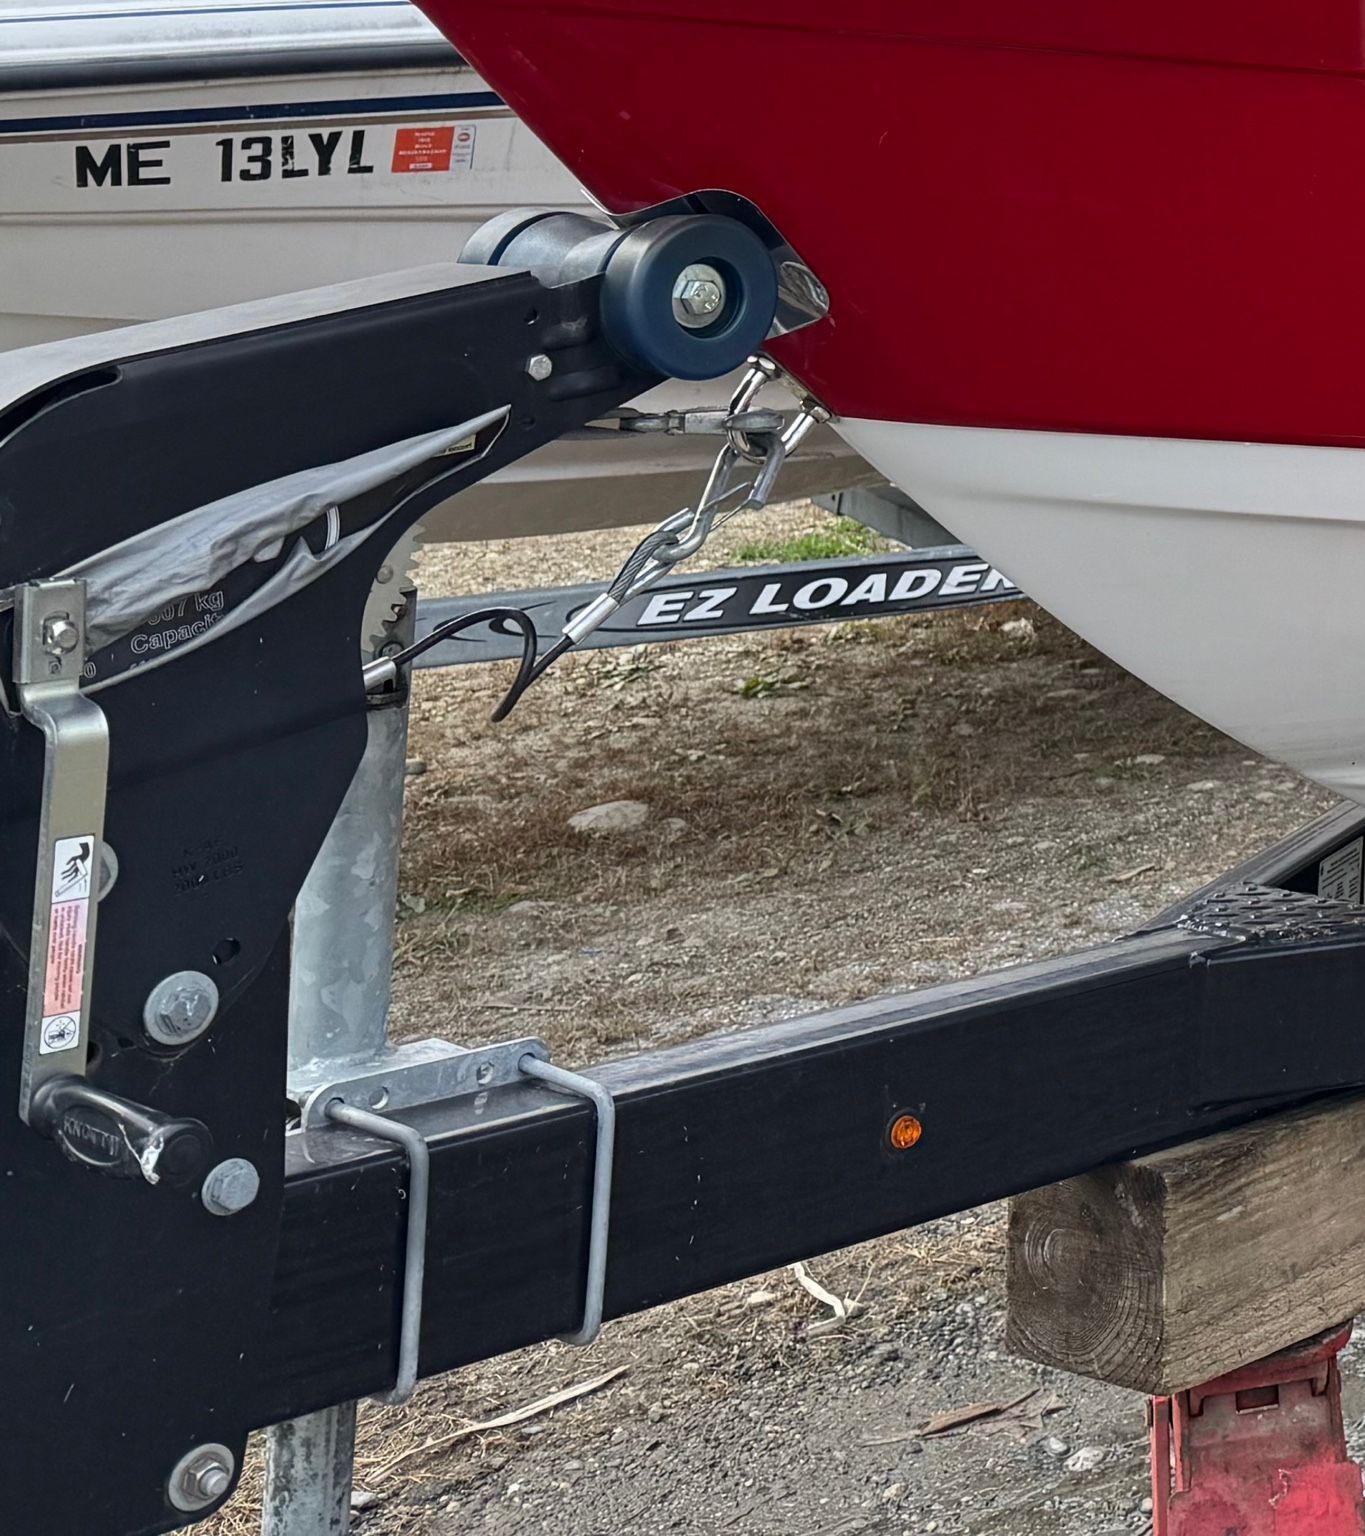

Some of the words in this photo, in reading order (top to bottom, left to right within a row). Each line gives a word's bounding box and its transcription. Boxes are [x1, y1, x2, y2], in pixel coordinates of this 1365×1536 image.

[75, 139, 171, 188] ME
[215, 129, 375, 183] 13LYL
[194, 590, 224, 613] kg
[636, 586, 738, 627] EZ
[130, 613, 223, 655] Capacit
